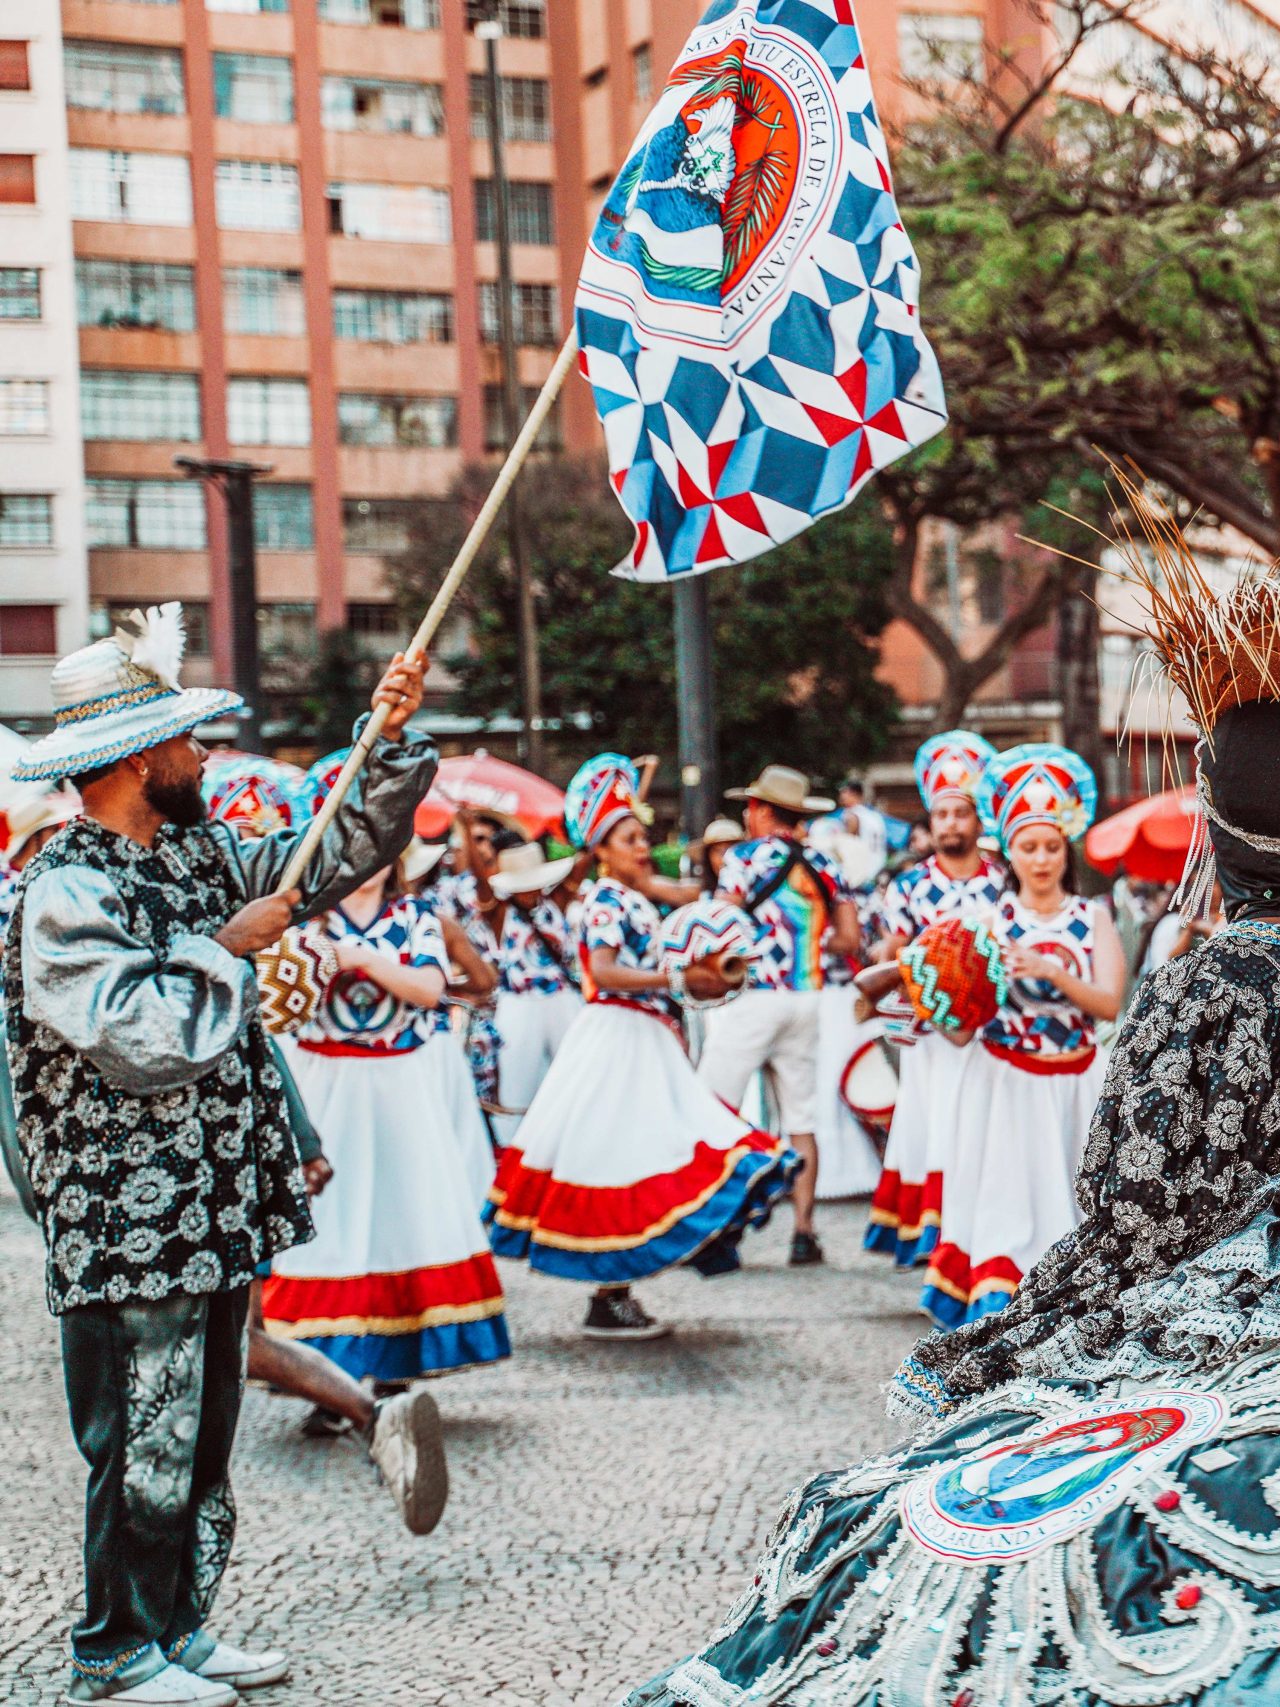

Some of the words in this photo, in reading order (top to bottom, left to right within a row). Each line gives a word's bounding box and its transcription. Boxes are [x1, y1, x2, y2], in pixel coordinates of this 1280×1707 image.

[780, 57, 827, 149] ESTRELA
[804, 157, 828, 189] DE
[728, 197, 812, 316] ARUANDA
